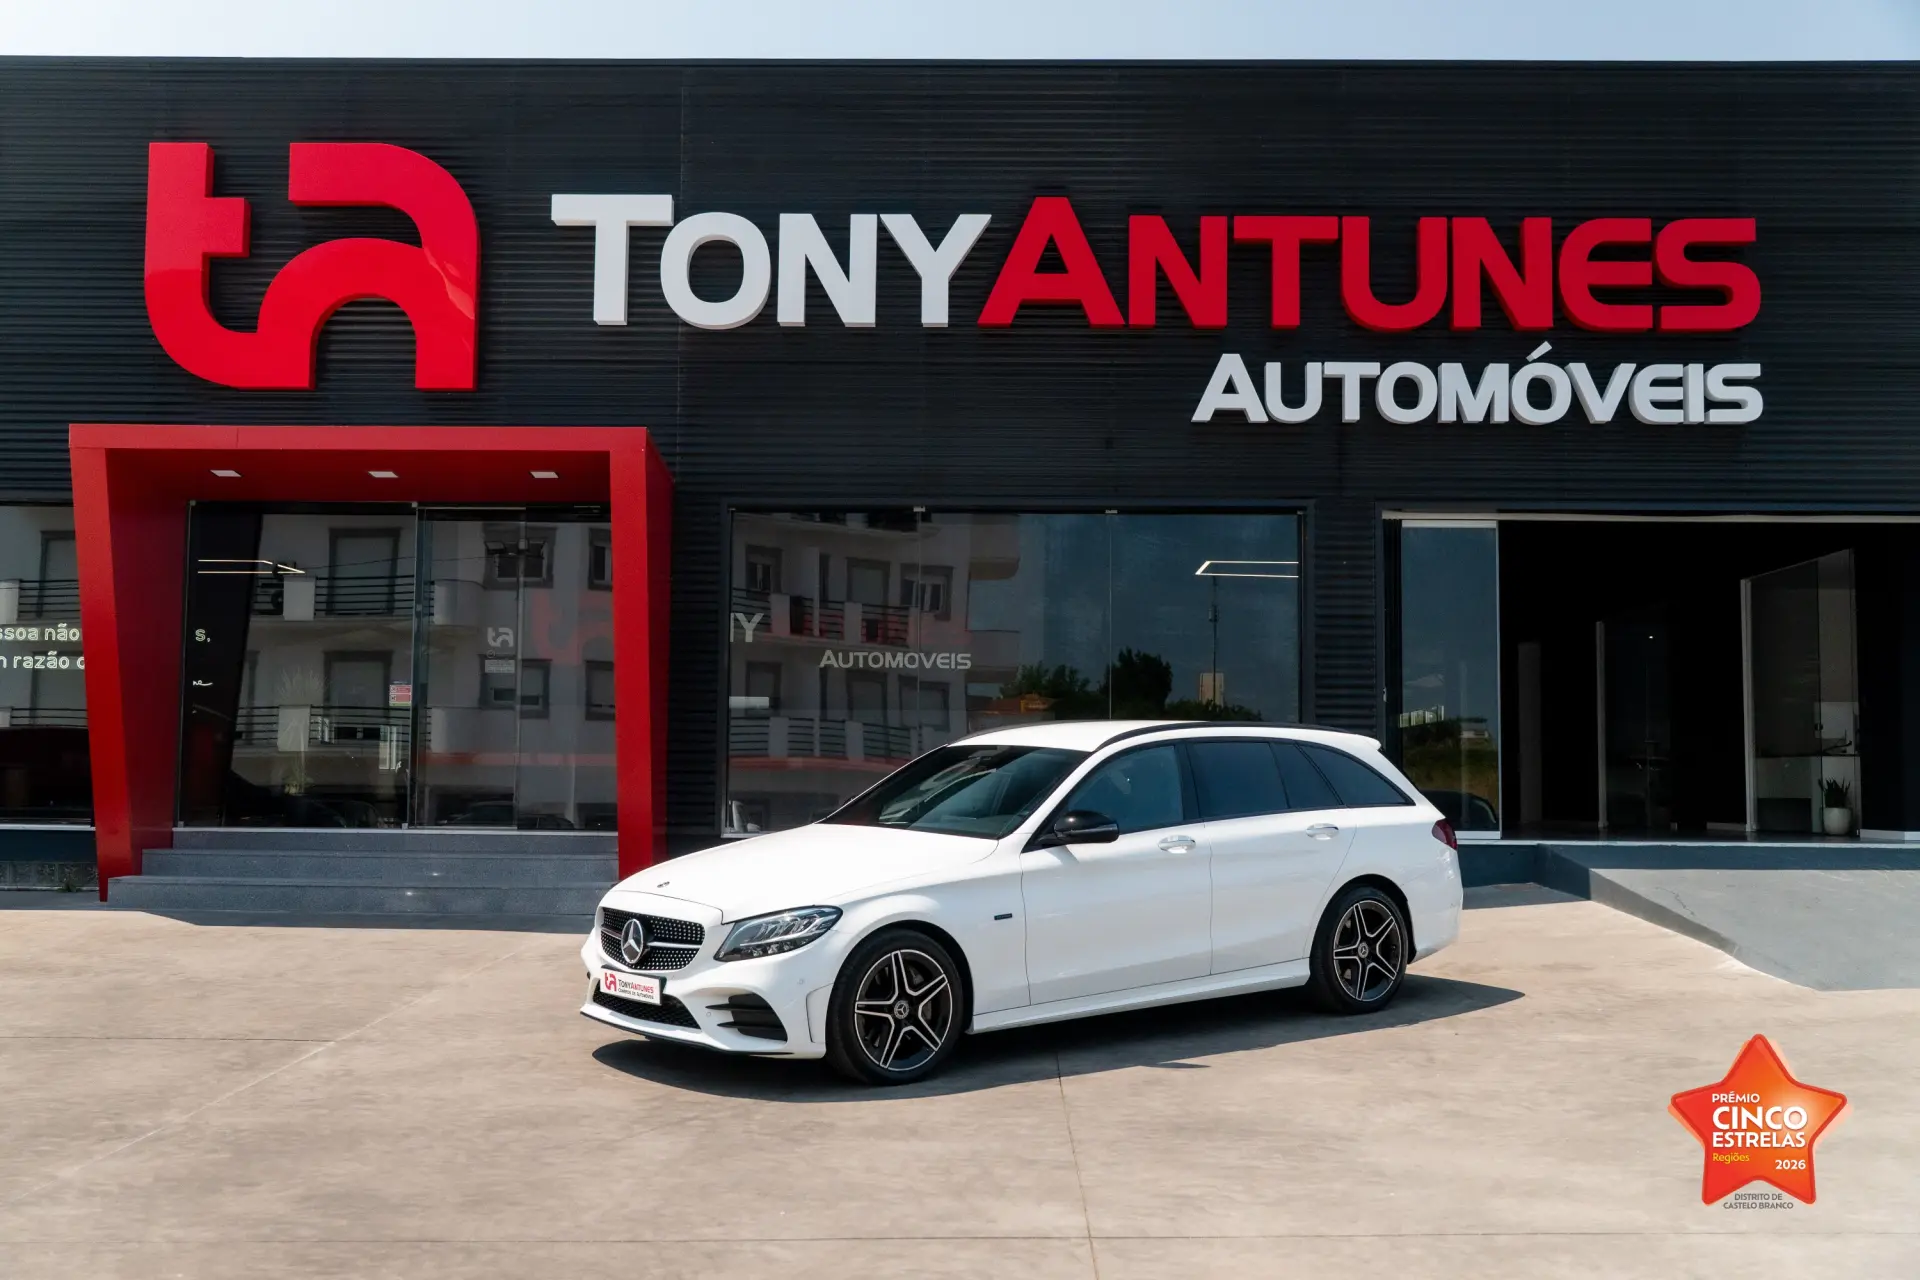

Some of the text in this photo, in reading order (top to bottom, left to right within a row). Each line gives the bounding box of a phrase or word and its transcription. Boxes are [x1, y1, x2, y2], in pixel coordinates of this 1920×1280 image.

[1191, 341, 1764, 425] AUTOMÓVEIS
[44, 622, 80, 641] não
[13, 650, 70, 669] razão
